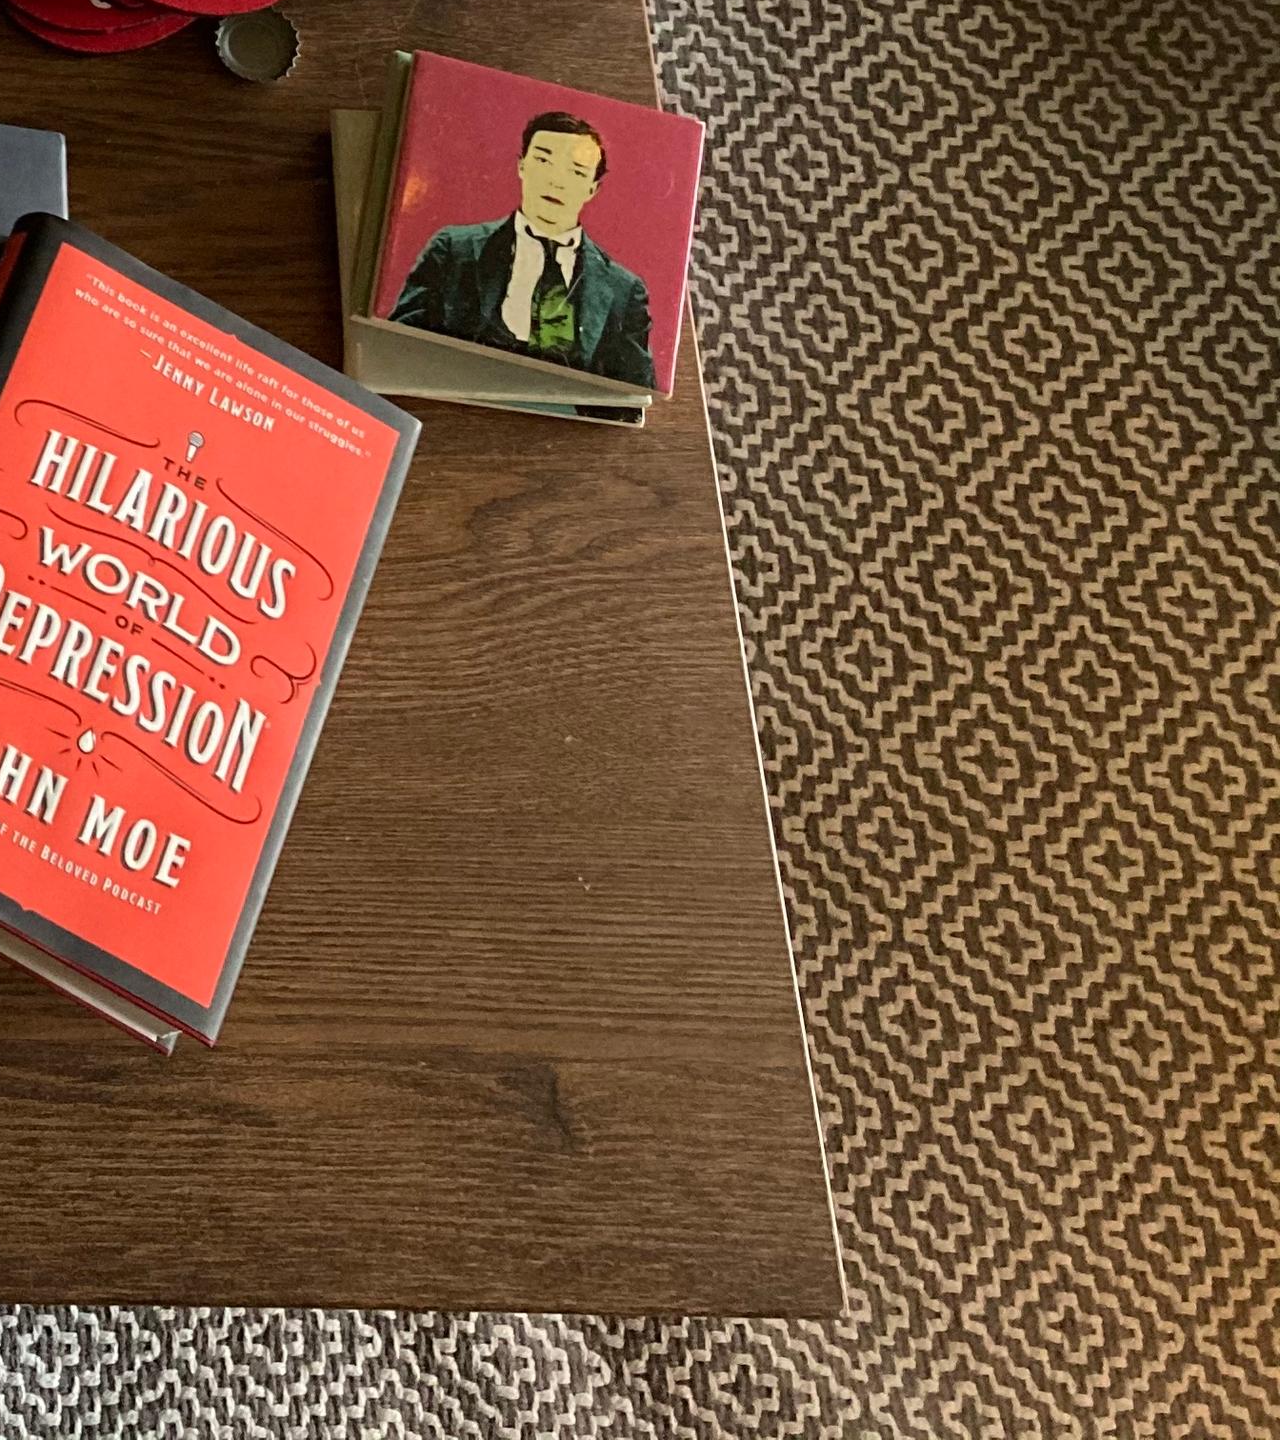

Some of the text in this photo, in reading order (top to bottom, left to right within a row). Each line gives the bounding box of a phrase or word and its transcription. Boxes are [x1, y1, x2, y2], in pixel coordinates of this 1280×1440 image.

[74, 286, 100, 308] who
[101, 303, 121, 319] are
[123, 315, 137, 329] so
[139, 324, 165, 345] sure
[167, 339, 192, 361] that
[195, 358, 212, 372] we
[213, 366, 233, 382] are
[236, 377, 268, 403] alone
[271, 397, 284, 412] in
[285, 407, 306, 424] our
[118, 288, 146, 315] book
[150, 307, 160, 322] is
[162, 318, 178, 334] an
[179, 327, 234, 363] excellent
[236, 355, 255, 376] life
[256, 367, 279, 389] raft
[281, 382, 299, 400] for
[301, 393, 334, 421] those
[336, 413, 351, 429] of
[351, 426, 366, 440] us
[28, 428, 297, 619] HILARIOUS
[163, 456, 207, 490] THE
[39, 525, 242, 667] WORLD
[115, 615, 144, 636] OF
[12, 831, 37, 853] THE
[40, 844, 98, 888] BELOVED
[102, 877, 162, 916] PODCAST
[76, 793, 191, 888] MOE
